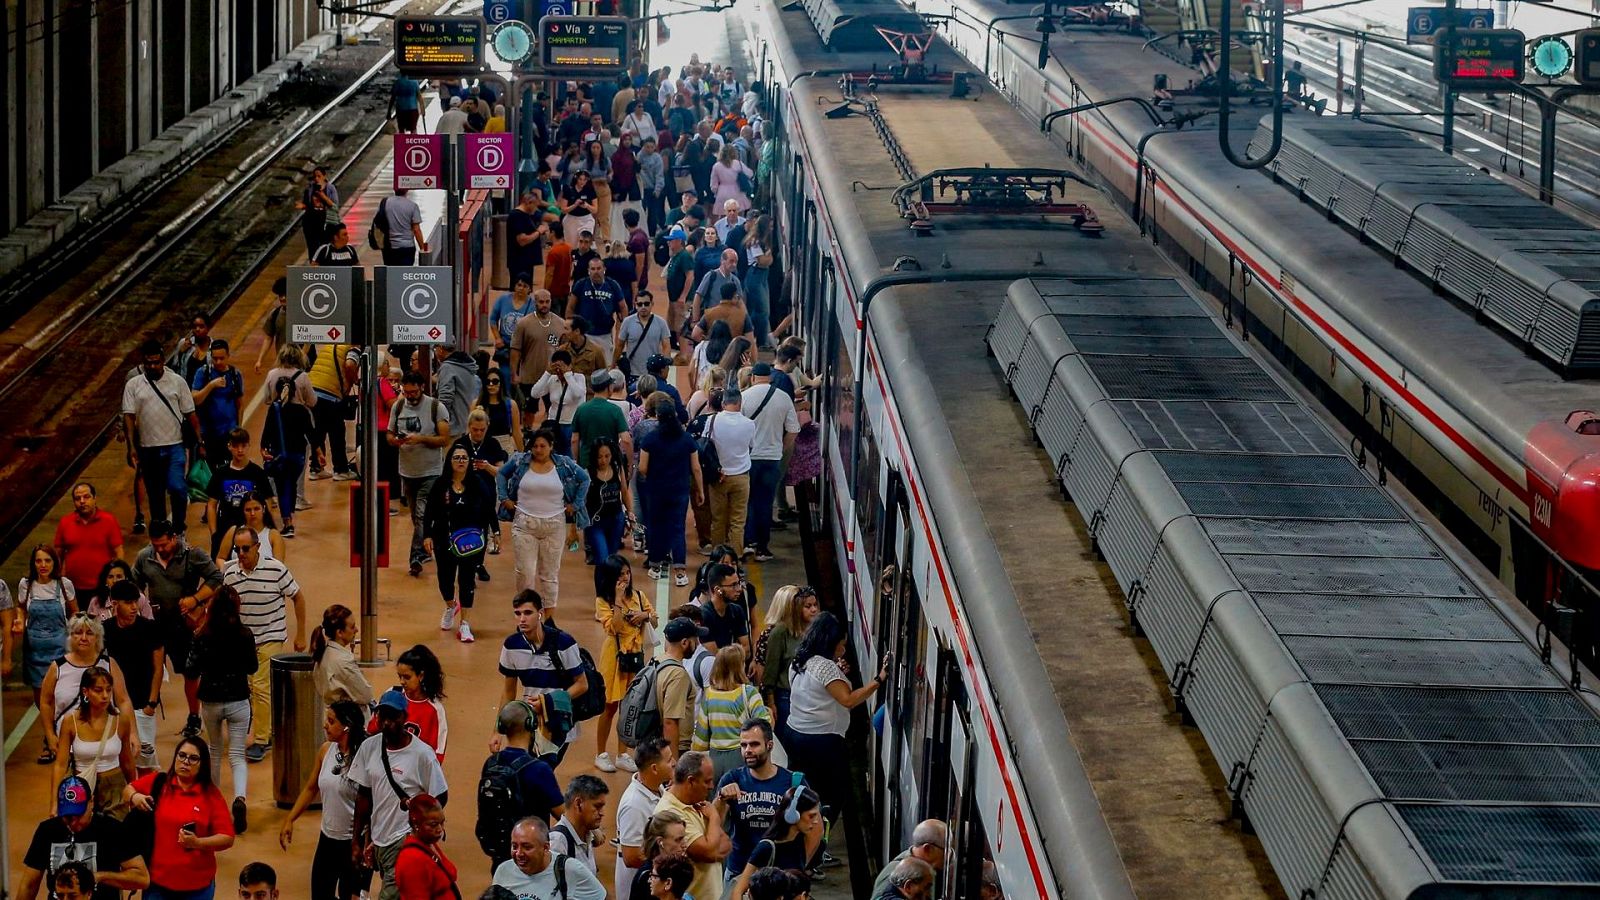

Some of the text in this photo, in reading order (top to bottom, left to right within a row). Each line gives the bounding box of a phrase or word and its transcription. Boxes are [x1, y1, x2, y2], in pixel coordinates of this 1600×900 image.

[495, 7, 504, 20] E
[440, 23, 445, 32] 1
[565, 24, 596, 34] Vía 2
[1418, 18, 1427, 31] E
[1483, 37, 1489, 46] 3
[411, 149, 427, 168] D
[483, 149, 499, 168] D
[302, 273, 336, 281] SECTOR
[402, 273, 437, 281] SECTOR
[308, 288, 330, 314] C
[408, 288, 431, 314] C
[296, 333, 324, 343] Platform
[331, 329, 337, 338] 1
[397, 333, 425, 343] Platform
[432, 329, 438, 338] 2
[1478, 488, 1503, 532] renfe
